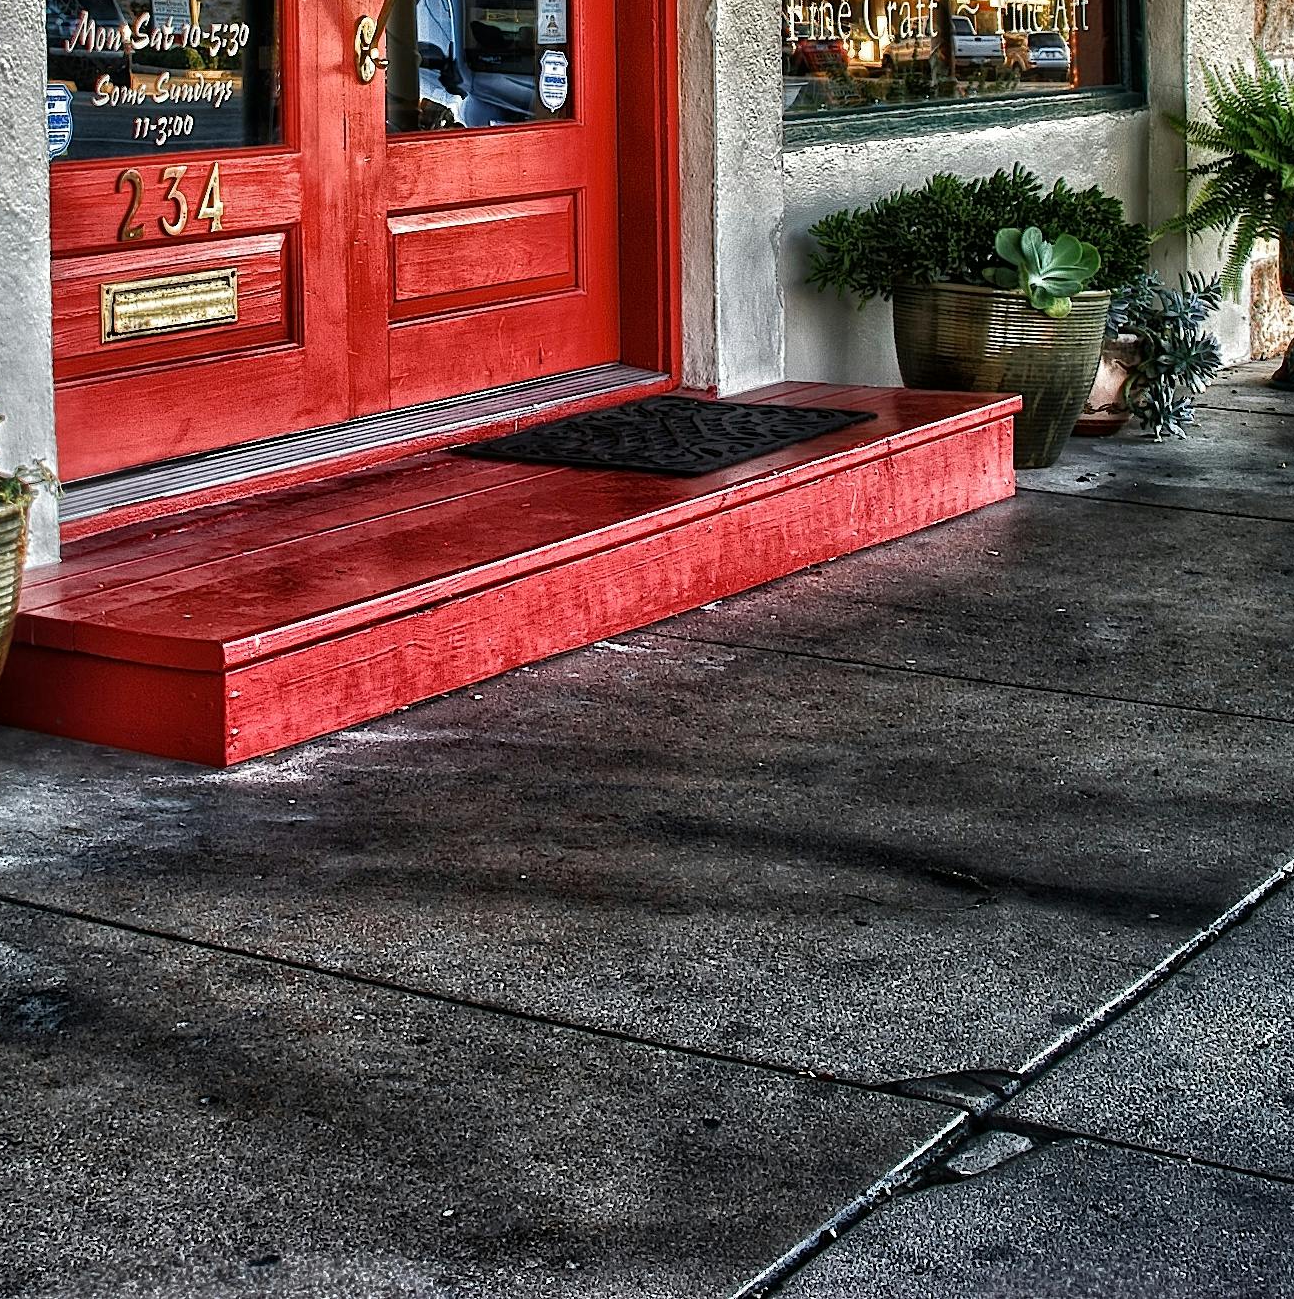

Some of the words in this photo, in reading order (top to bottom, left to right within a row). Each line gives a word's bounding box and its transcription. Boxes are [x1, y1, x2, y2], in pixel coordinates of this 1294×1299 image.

[181, 21, 250, 57] 10-5:30
[92, 74, 147, 107] Some
[152, 71, 234, 109] Sundays
[133, 114, 195, 146] 11-3:00
[116, 161, 225, 242] 234
